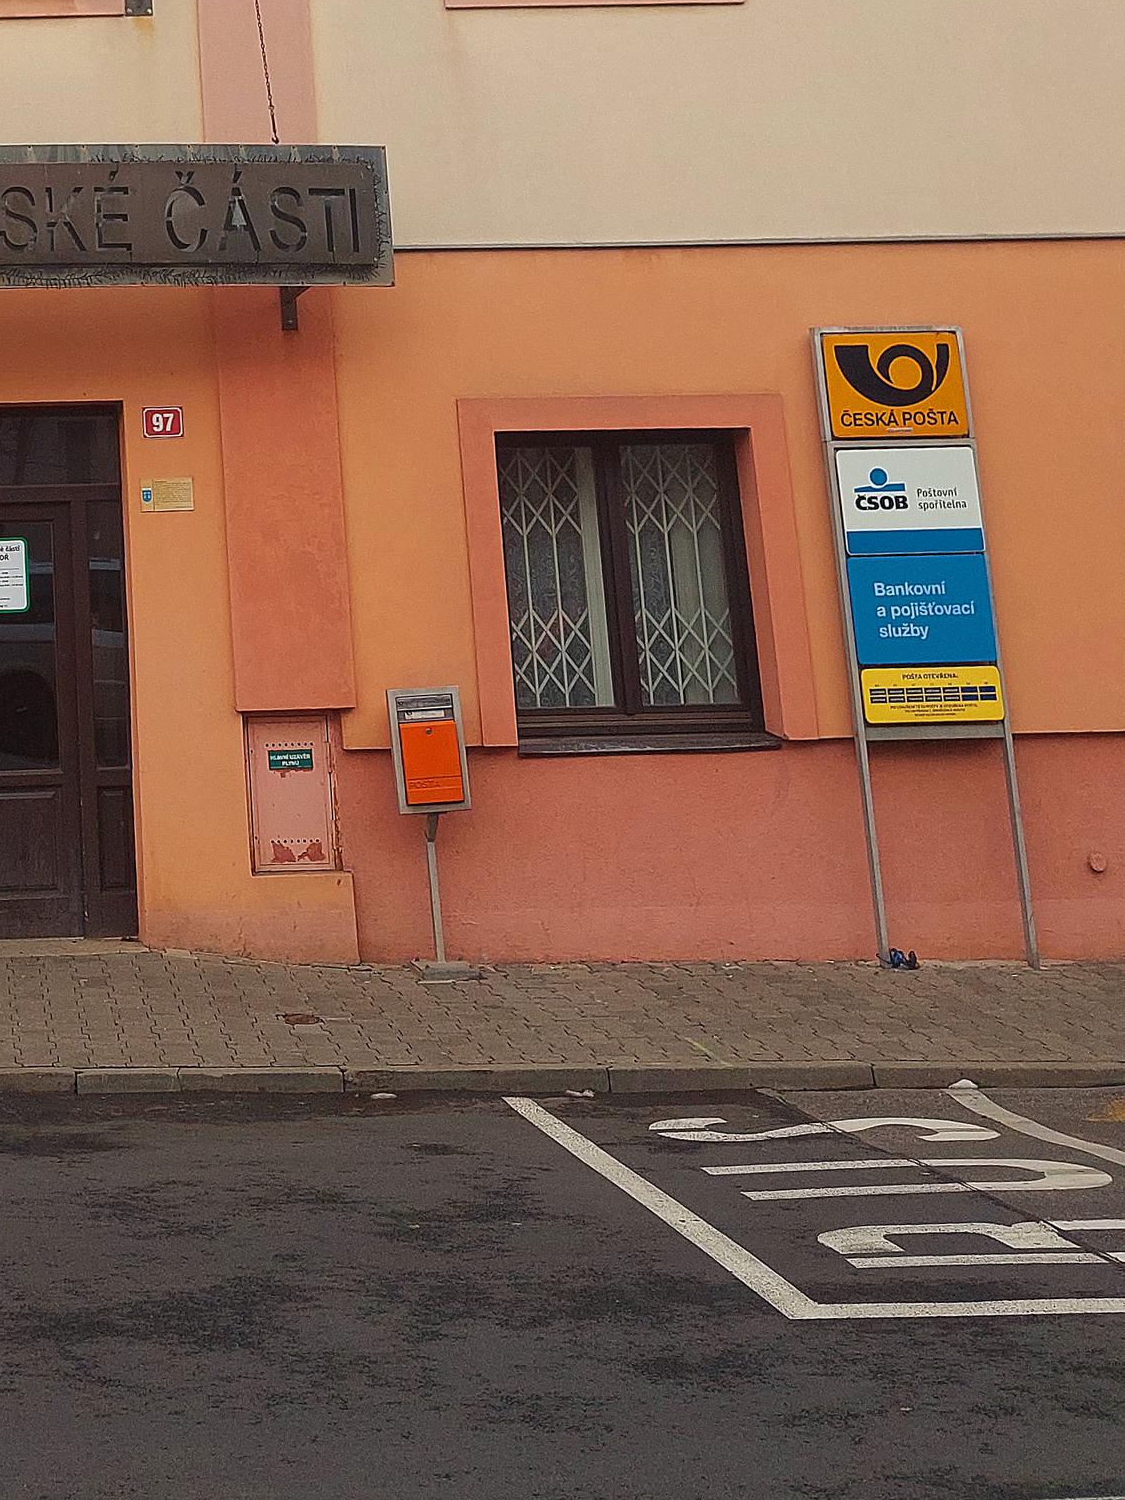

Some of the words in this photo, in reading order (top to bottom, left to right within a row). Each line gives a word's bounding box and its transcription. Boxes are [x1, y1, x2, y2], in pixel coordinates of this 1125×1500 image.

[164, 170, 361, 253] ČÁSTI
[151, 413, 174, 432] 97
[840, 409, 899, 427] ČESKÁ
[902, 408, 959, 426] POŠTA
[916, 487, 958, 499] Poštovní
[855, 494, 909, 511] ČSOB
[918, 499, 967, 512] spořitelna
[874, 580, 946, 597] Bankovní
[876, 606, 887, 617] a
[891, 600, 975, 620] pojišťovací
[879, 623, 929, 640] služby
